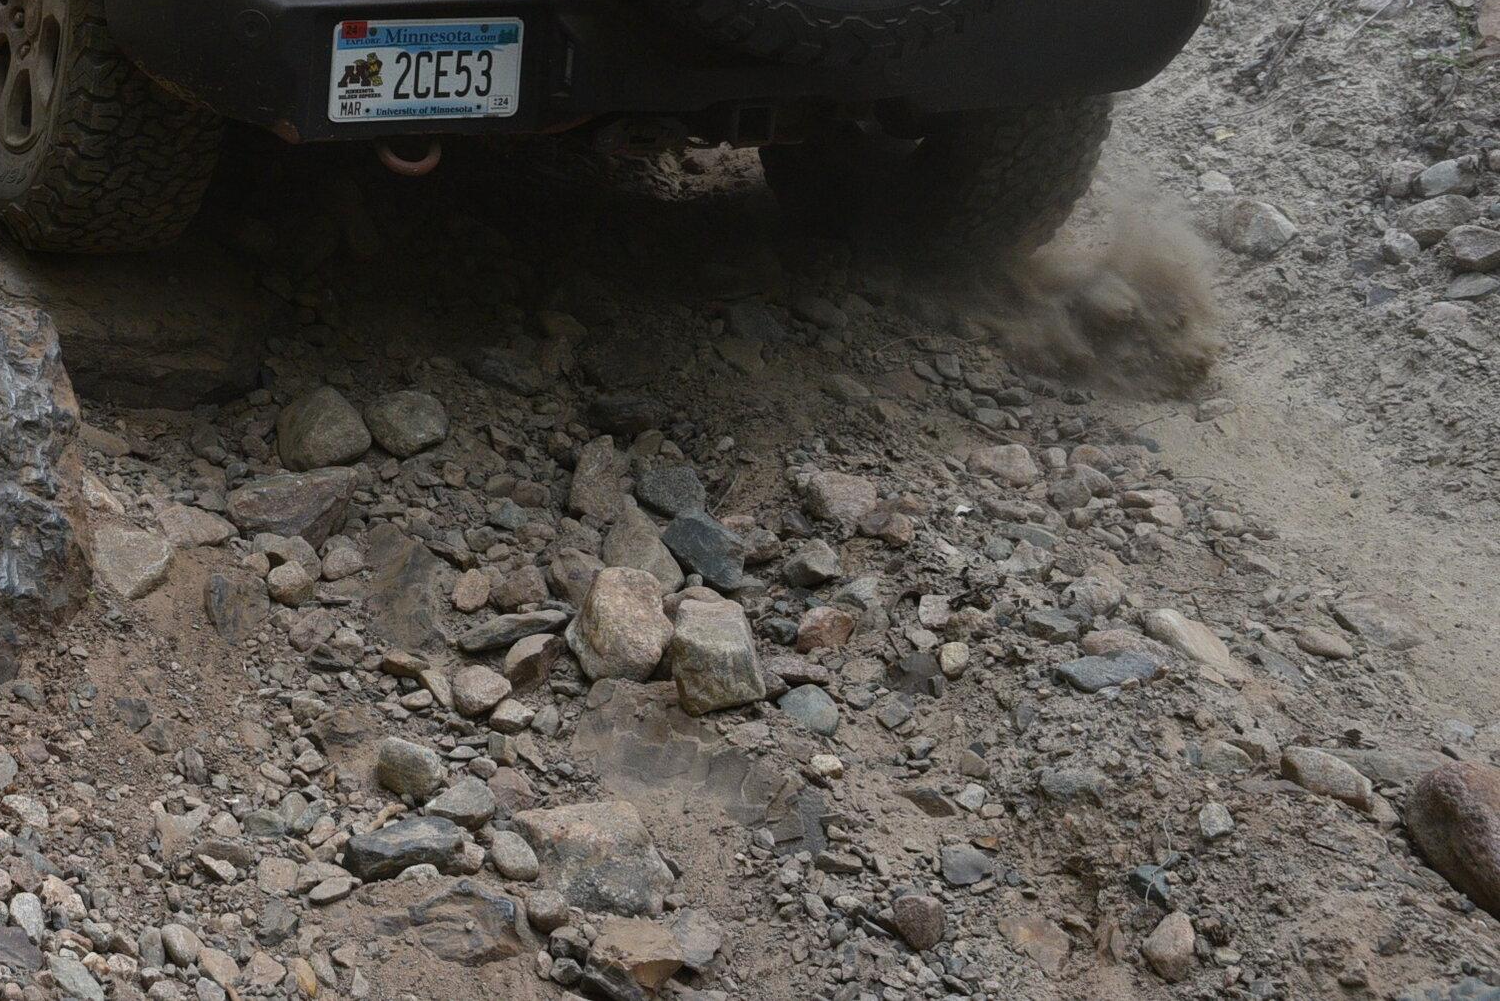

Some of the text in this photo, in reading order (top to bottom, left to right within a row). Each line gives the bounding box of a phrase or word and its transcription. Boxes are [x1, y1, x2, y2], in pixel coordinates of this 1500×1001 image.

[393, 50, 493, 99] 2CE53
[340, 101, 362, 116] MAR
[376, 106, 473, 116] University of Minnesota
